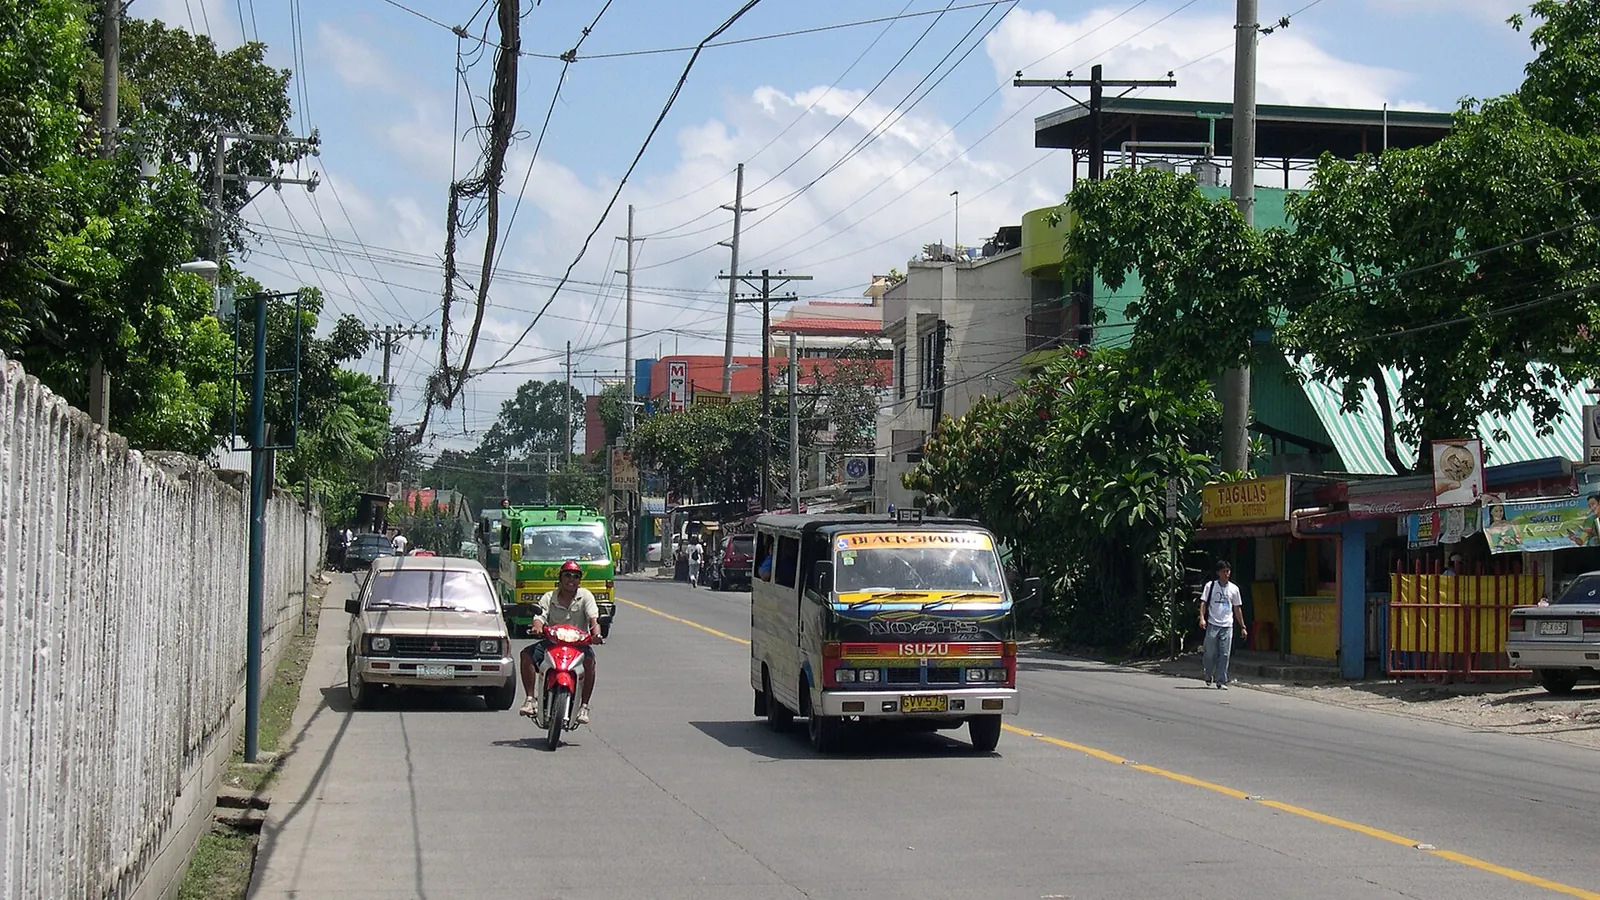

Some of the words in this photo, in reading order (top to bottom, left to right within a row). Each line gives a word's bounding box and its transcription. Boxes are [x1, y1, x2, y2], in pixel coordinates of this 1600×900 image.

[1218, 484, 1267, 505] TAGALAS
[1514, 502, 1536, 511] LOAD
[1540, 501, 1553, 509] NA
[1529, 514, 1561, 524] SMART
[851, 535, 907, 545] BLACK
[899, 643, 949, 656] ISUZU
[902, 695, 946, 708] GVV-579
